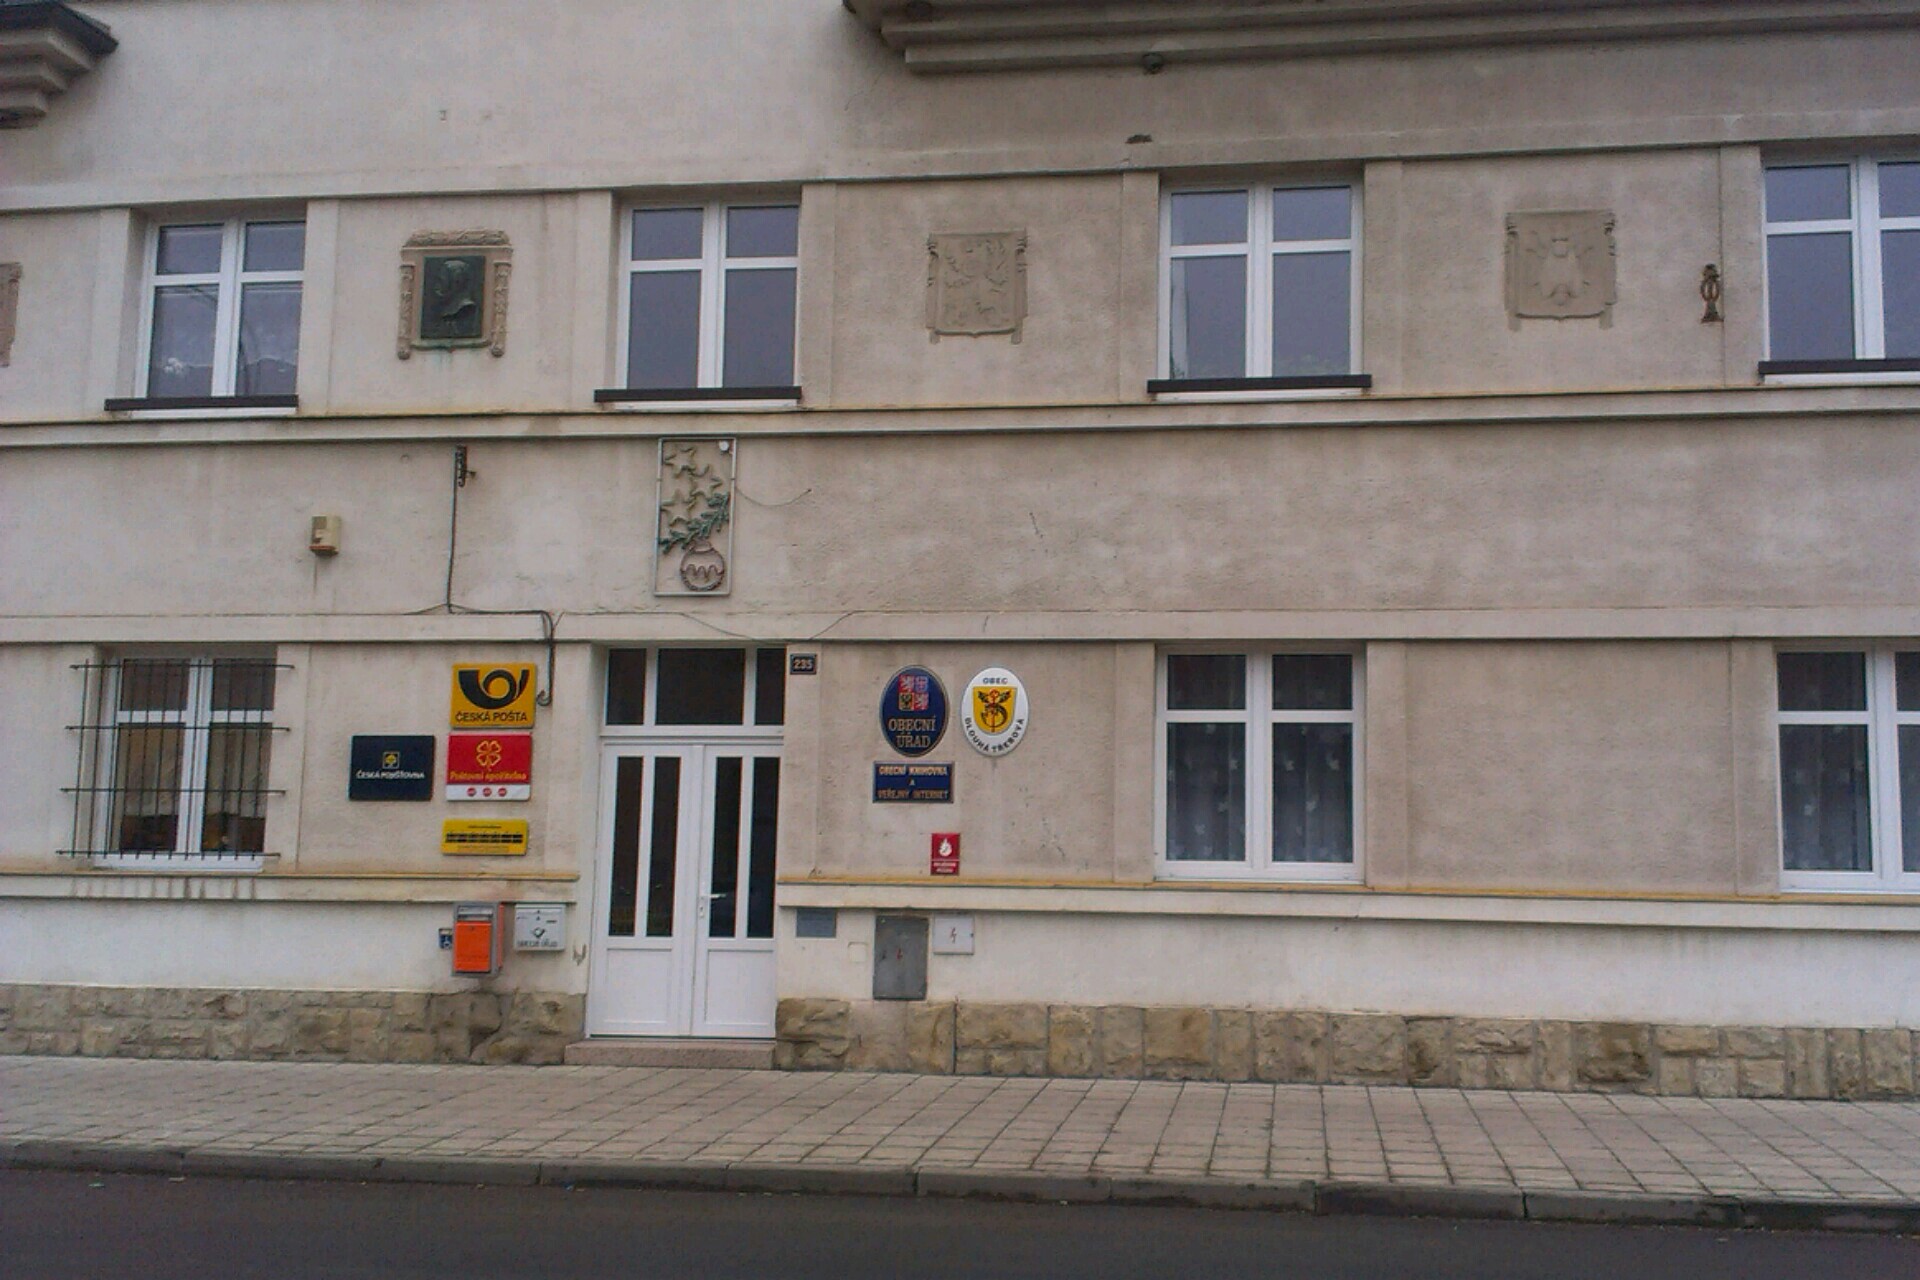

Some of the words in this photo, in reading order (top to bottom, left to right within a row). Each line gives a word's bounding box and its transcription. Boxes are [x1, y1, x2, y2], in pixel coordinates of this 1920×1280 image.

[455, 710, 490, 722] ČESKÁ
[493, 711, 527, 722] POŠTA
[888, 714, 936, 732] OBECNÍ
[896, 732, 931, 748] ÚŘAD
